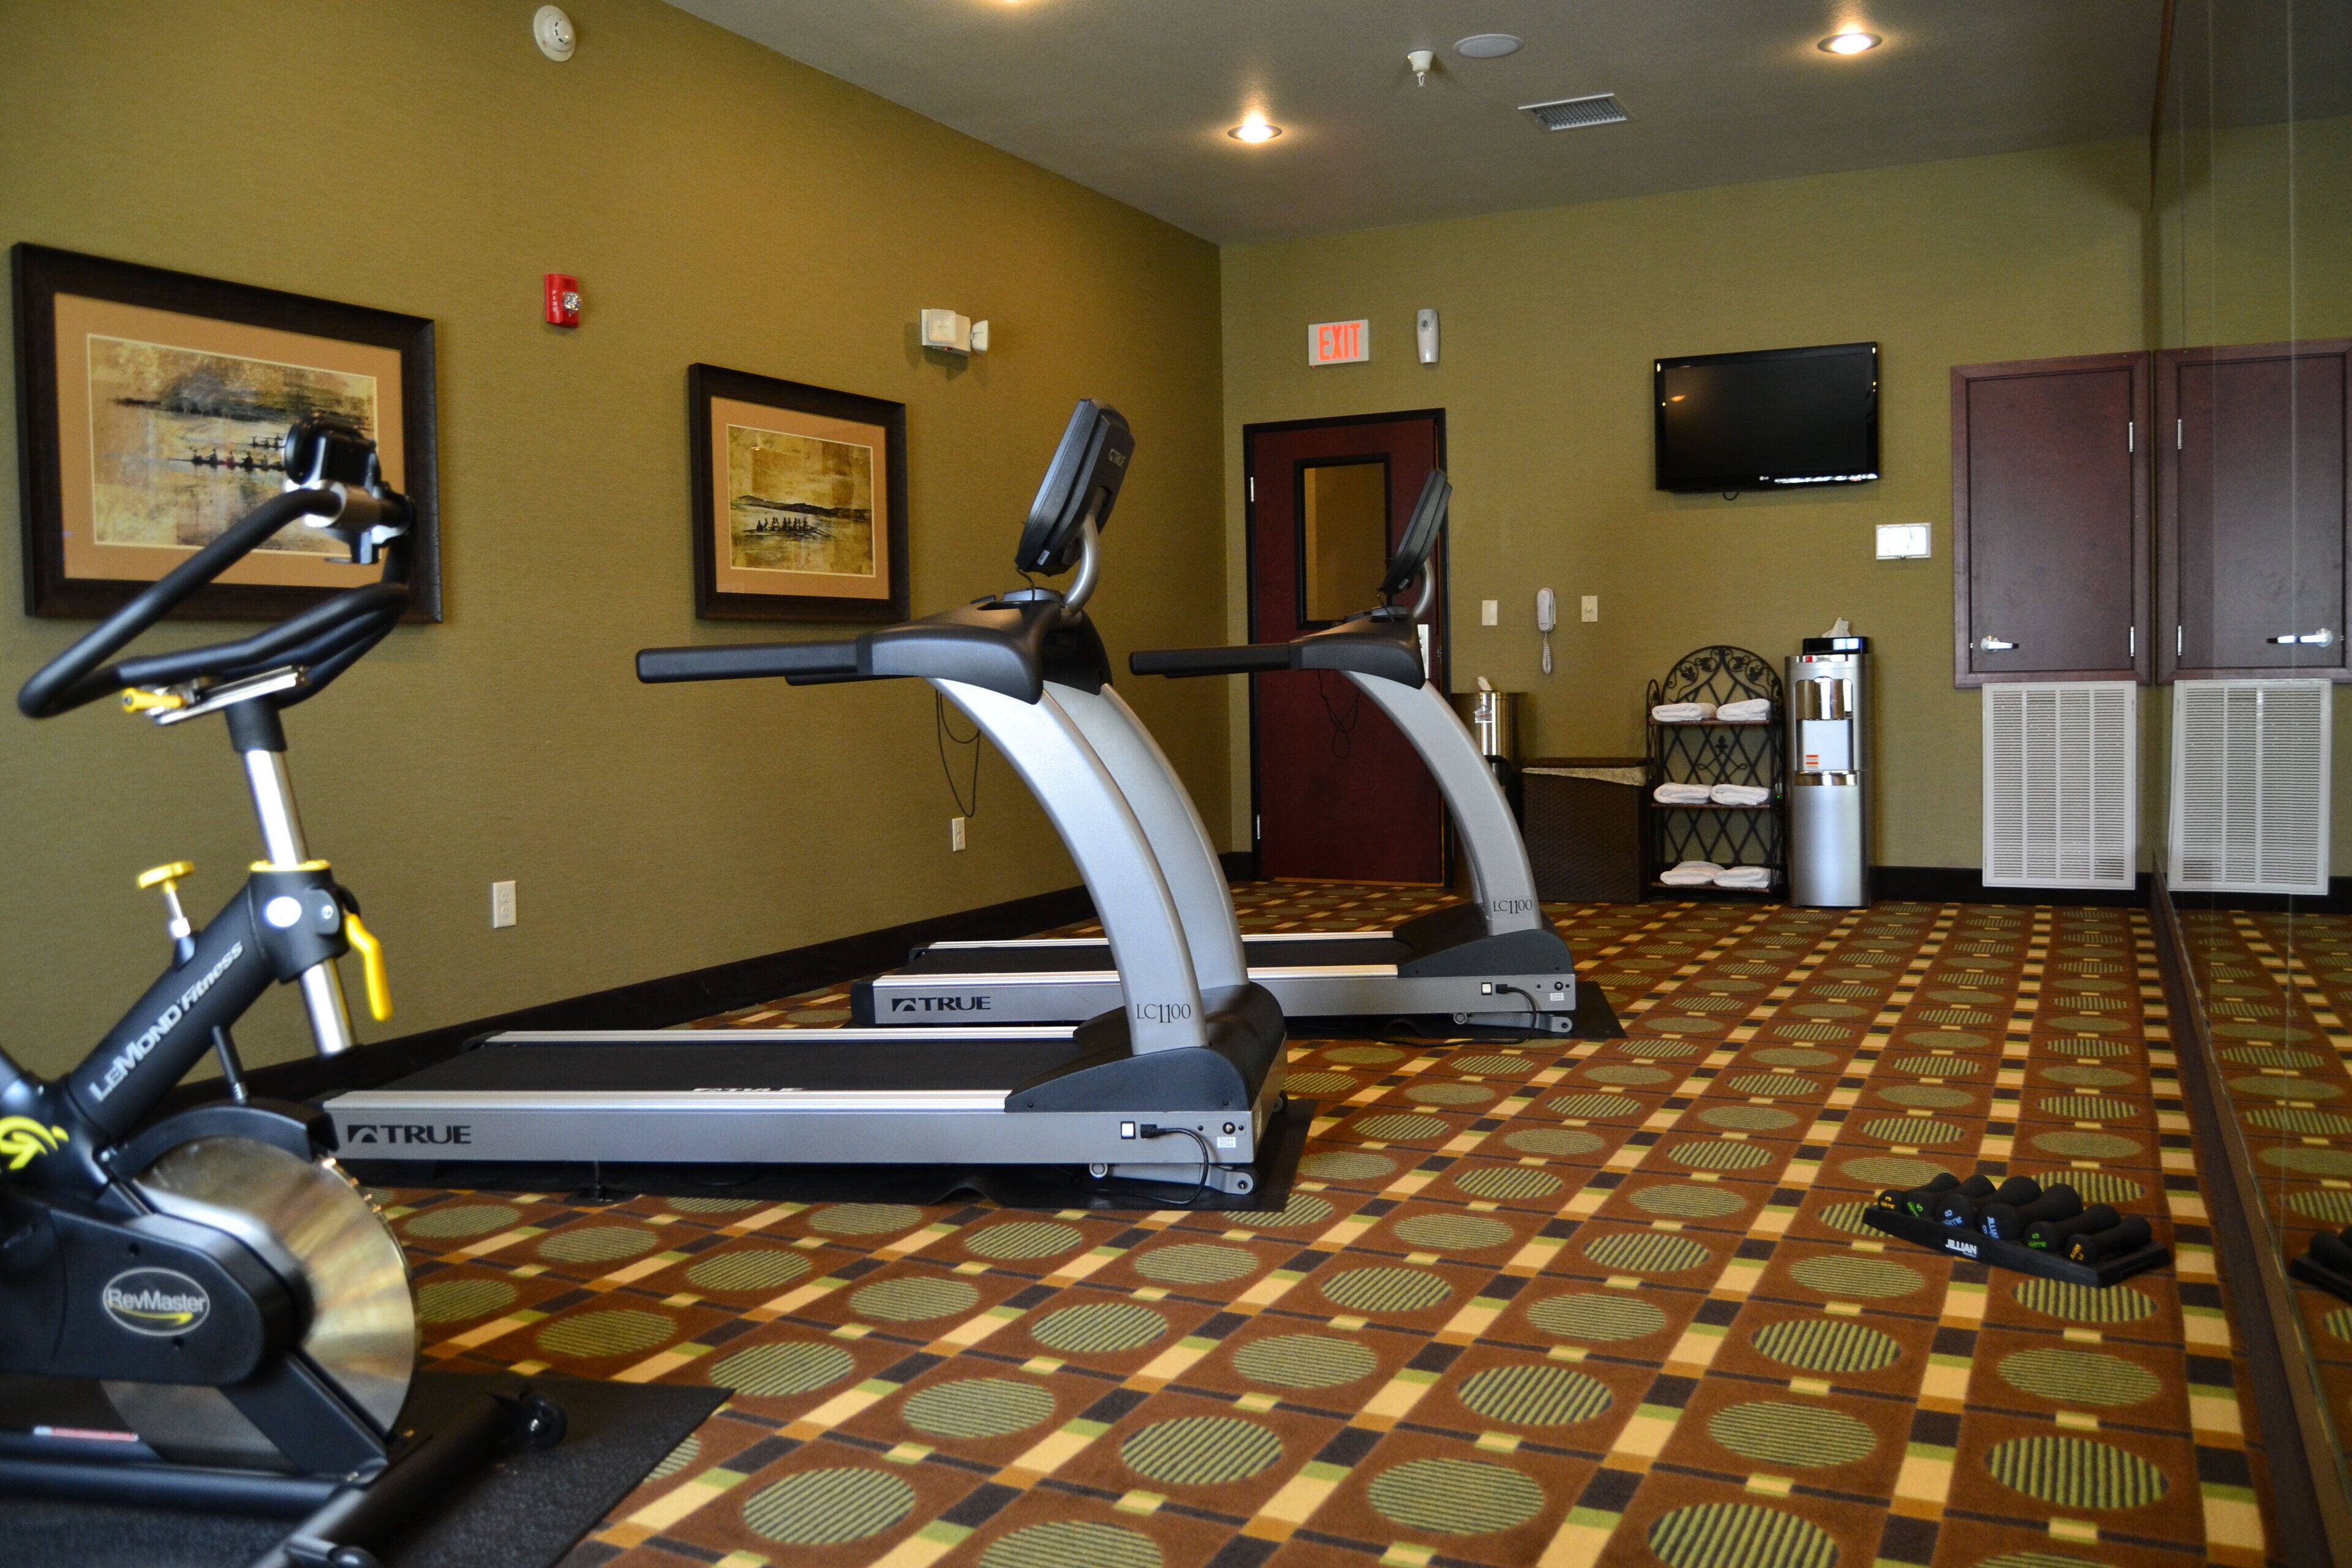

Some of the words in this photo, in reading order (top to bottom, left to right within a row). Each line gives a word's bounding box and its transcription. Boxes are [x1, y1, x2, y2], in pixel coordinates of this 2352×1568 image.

[1318, 322, 1362, 361] EXIT
[1493, 899, 1532, 914] LC1100
[181, 941, 243, 1011] Fitness
[918, 996, 991, 1011] TRUE
[1137, 1003, 1191, 1023] LC1100
[380, 1125, 472, 1144] TRUE
[1945, 1238, 1977, 1256] JILLIAN
[107, 1288, 206, 1313] RevMaster
